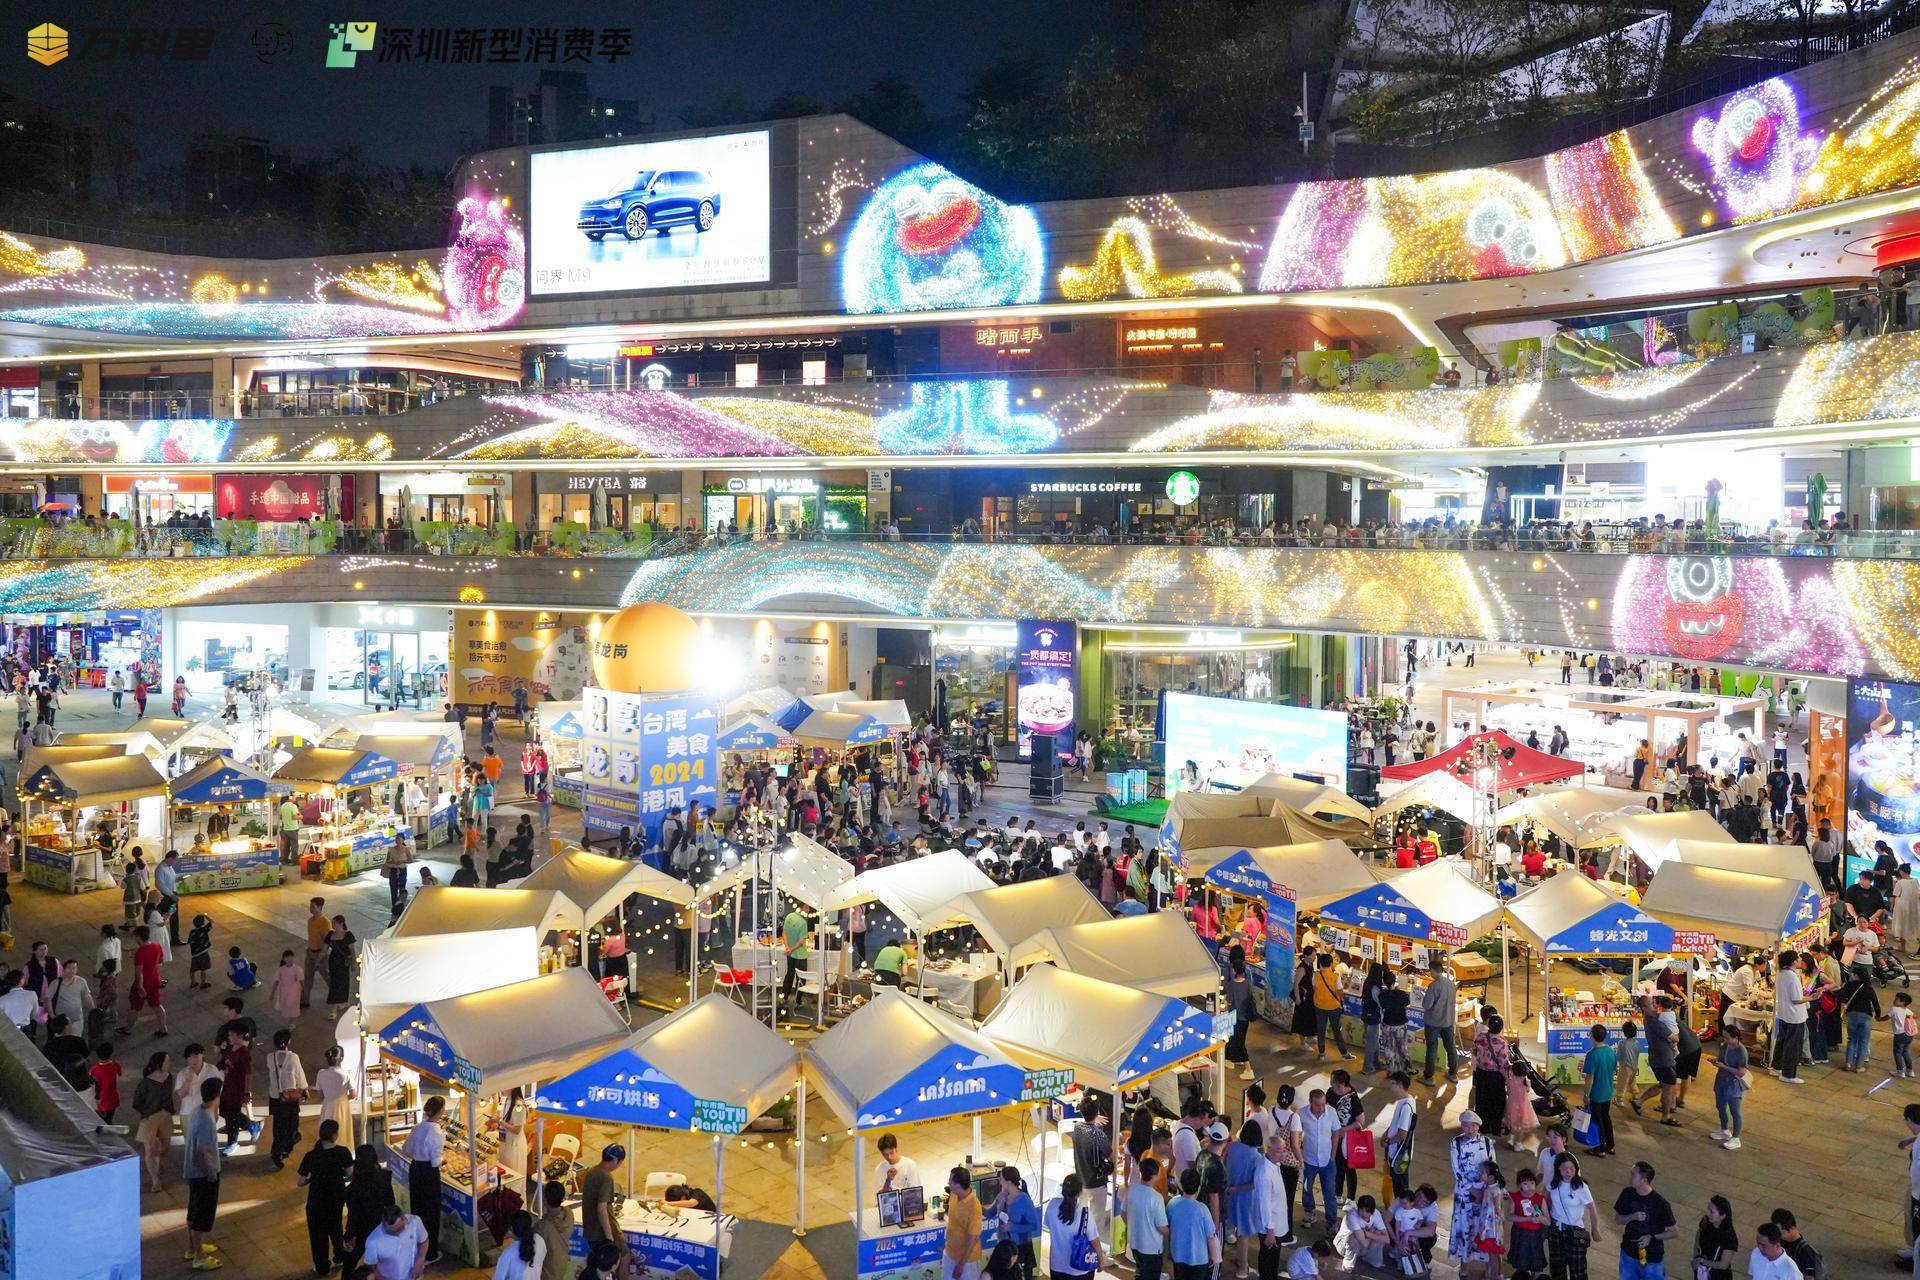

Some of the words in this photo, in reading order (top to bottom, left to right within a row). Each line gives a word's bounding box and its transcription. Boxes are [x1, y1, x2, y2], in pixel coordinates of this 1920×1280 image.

[536, 268, 563, 285] 问界
[567, 267, 591, 283] M9
[1030, 483, 1097, 492] STARBUCKS
[1098, 483, 1142, 492] COFFEE
[643, 709, 688, 736] 台湾
[666, 732, 710, 758] 美食
[650, 759, 705, 786] 2024
[642, 787, 687, 813] 港风
[1428, 932, 1462, 946] Market
[1436, 927, 1468, 940] YOUTH
[1681, 934, 1715, 945] YOUTH
[1671, 943, 1709, 953] Market
[1033, 1070, 1074, 1088] YOUTH
[1020, 1085, 1066, 1101] Market
[702, 1107, 746, 1123] YOUTH
[691, 1117, 738, 1134] Market
[875, 1239, 897, 1252] 2024
